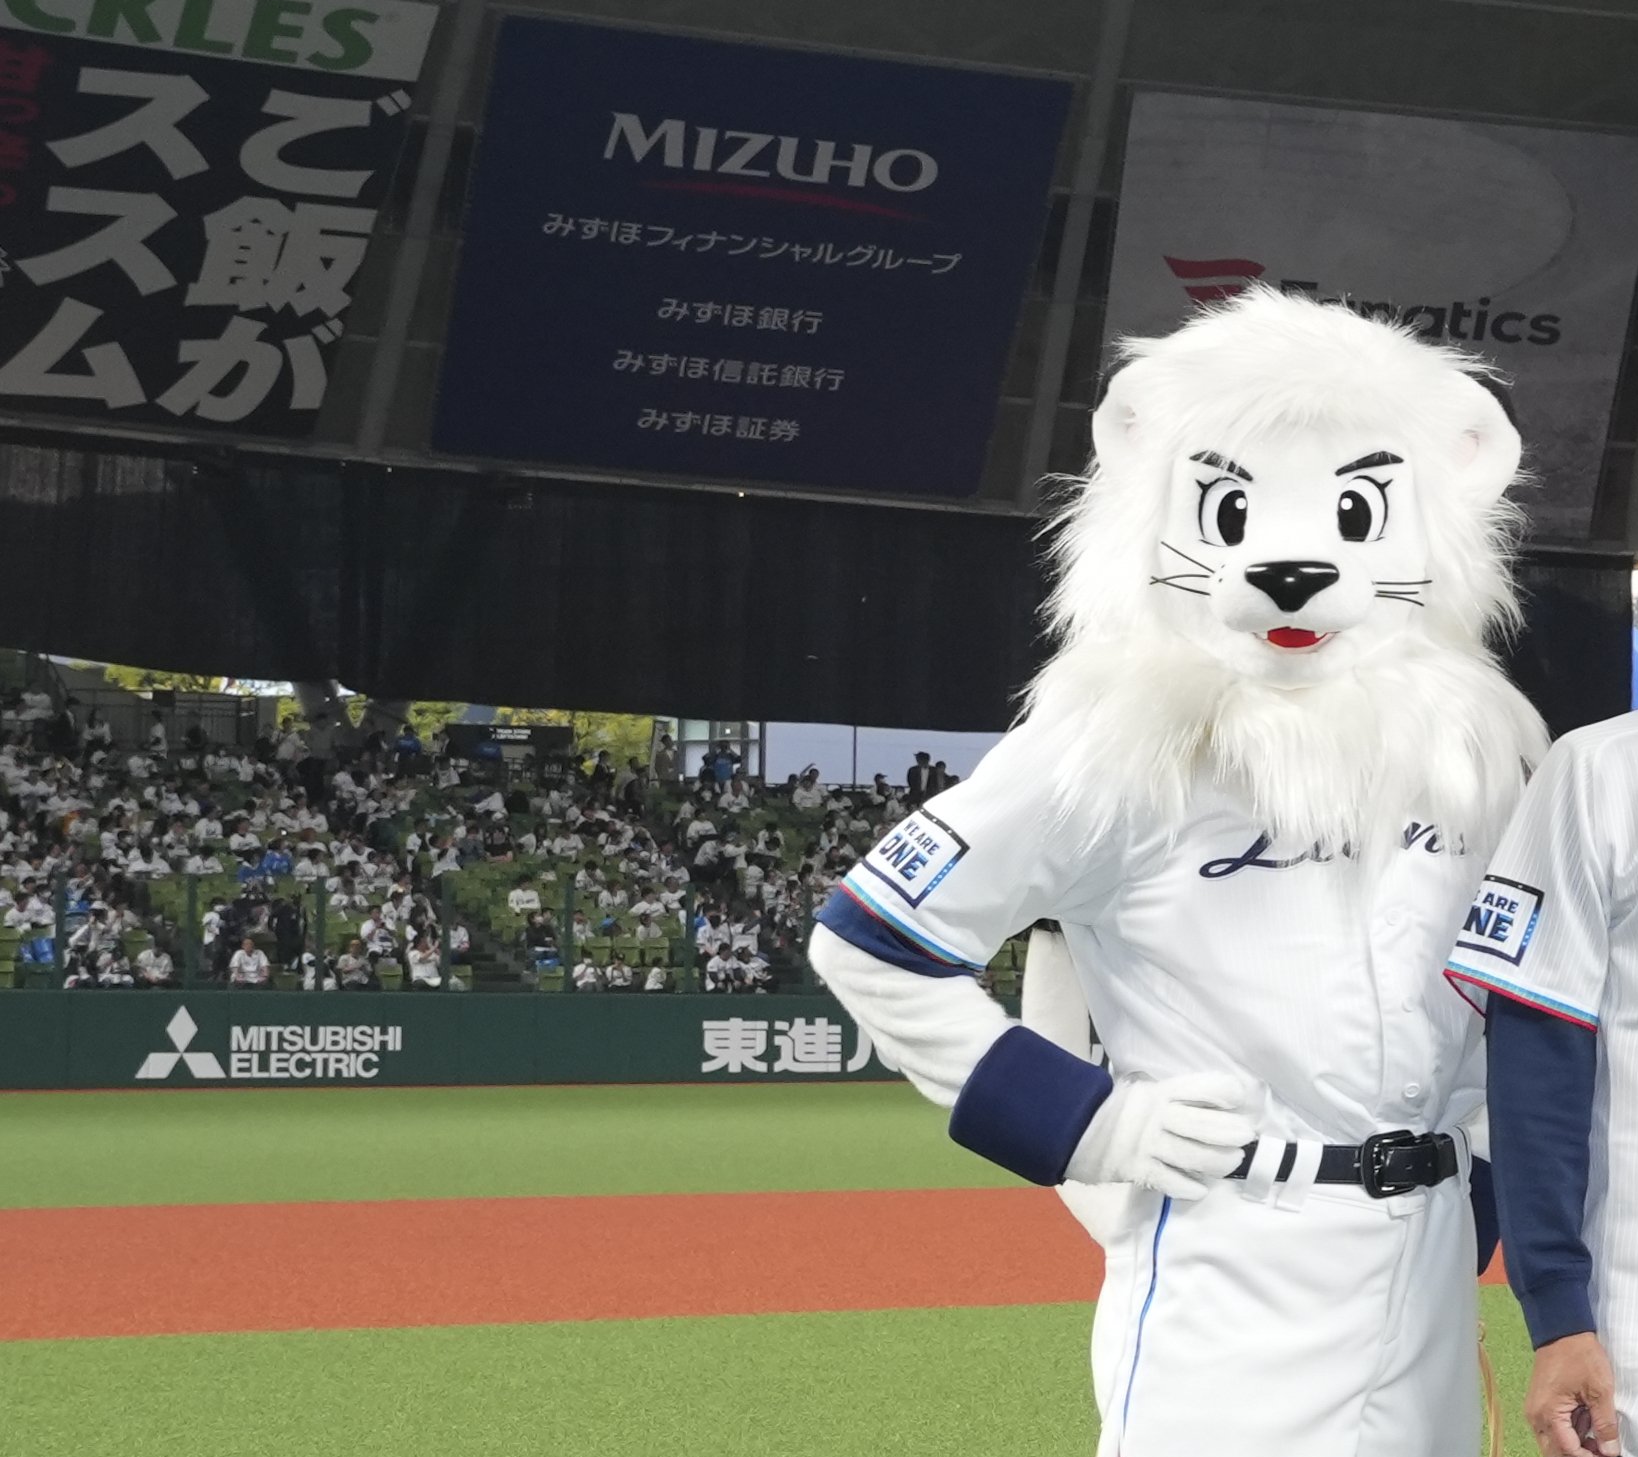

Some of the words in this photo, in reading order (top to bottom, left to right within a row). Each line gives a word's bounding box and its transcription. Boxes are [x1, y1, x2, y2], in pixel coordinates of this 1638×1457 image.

[603, 111, 939, 193] MIZUHO
[541, 213, 963, 275] みずほフィナンシャルグループ
[657, 297, 824, 335] みずほ銀行
[1280, 278, 1562, 346] natics
[612, 349, 845, 392] みずほ信託銀行
[637, 408, 801, 443] みずほ証券
[878, 832, 929, 881] ONE
[230, 1025, 402, 1052] MITSUBISHI
[230, 1052, 379, 1079] ELECTRIC
